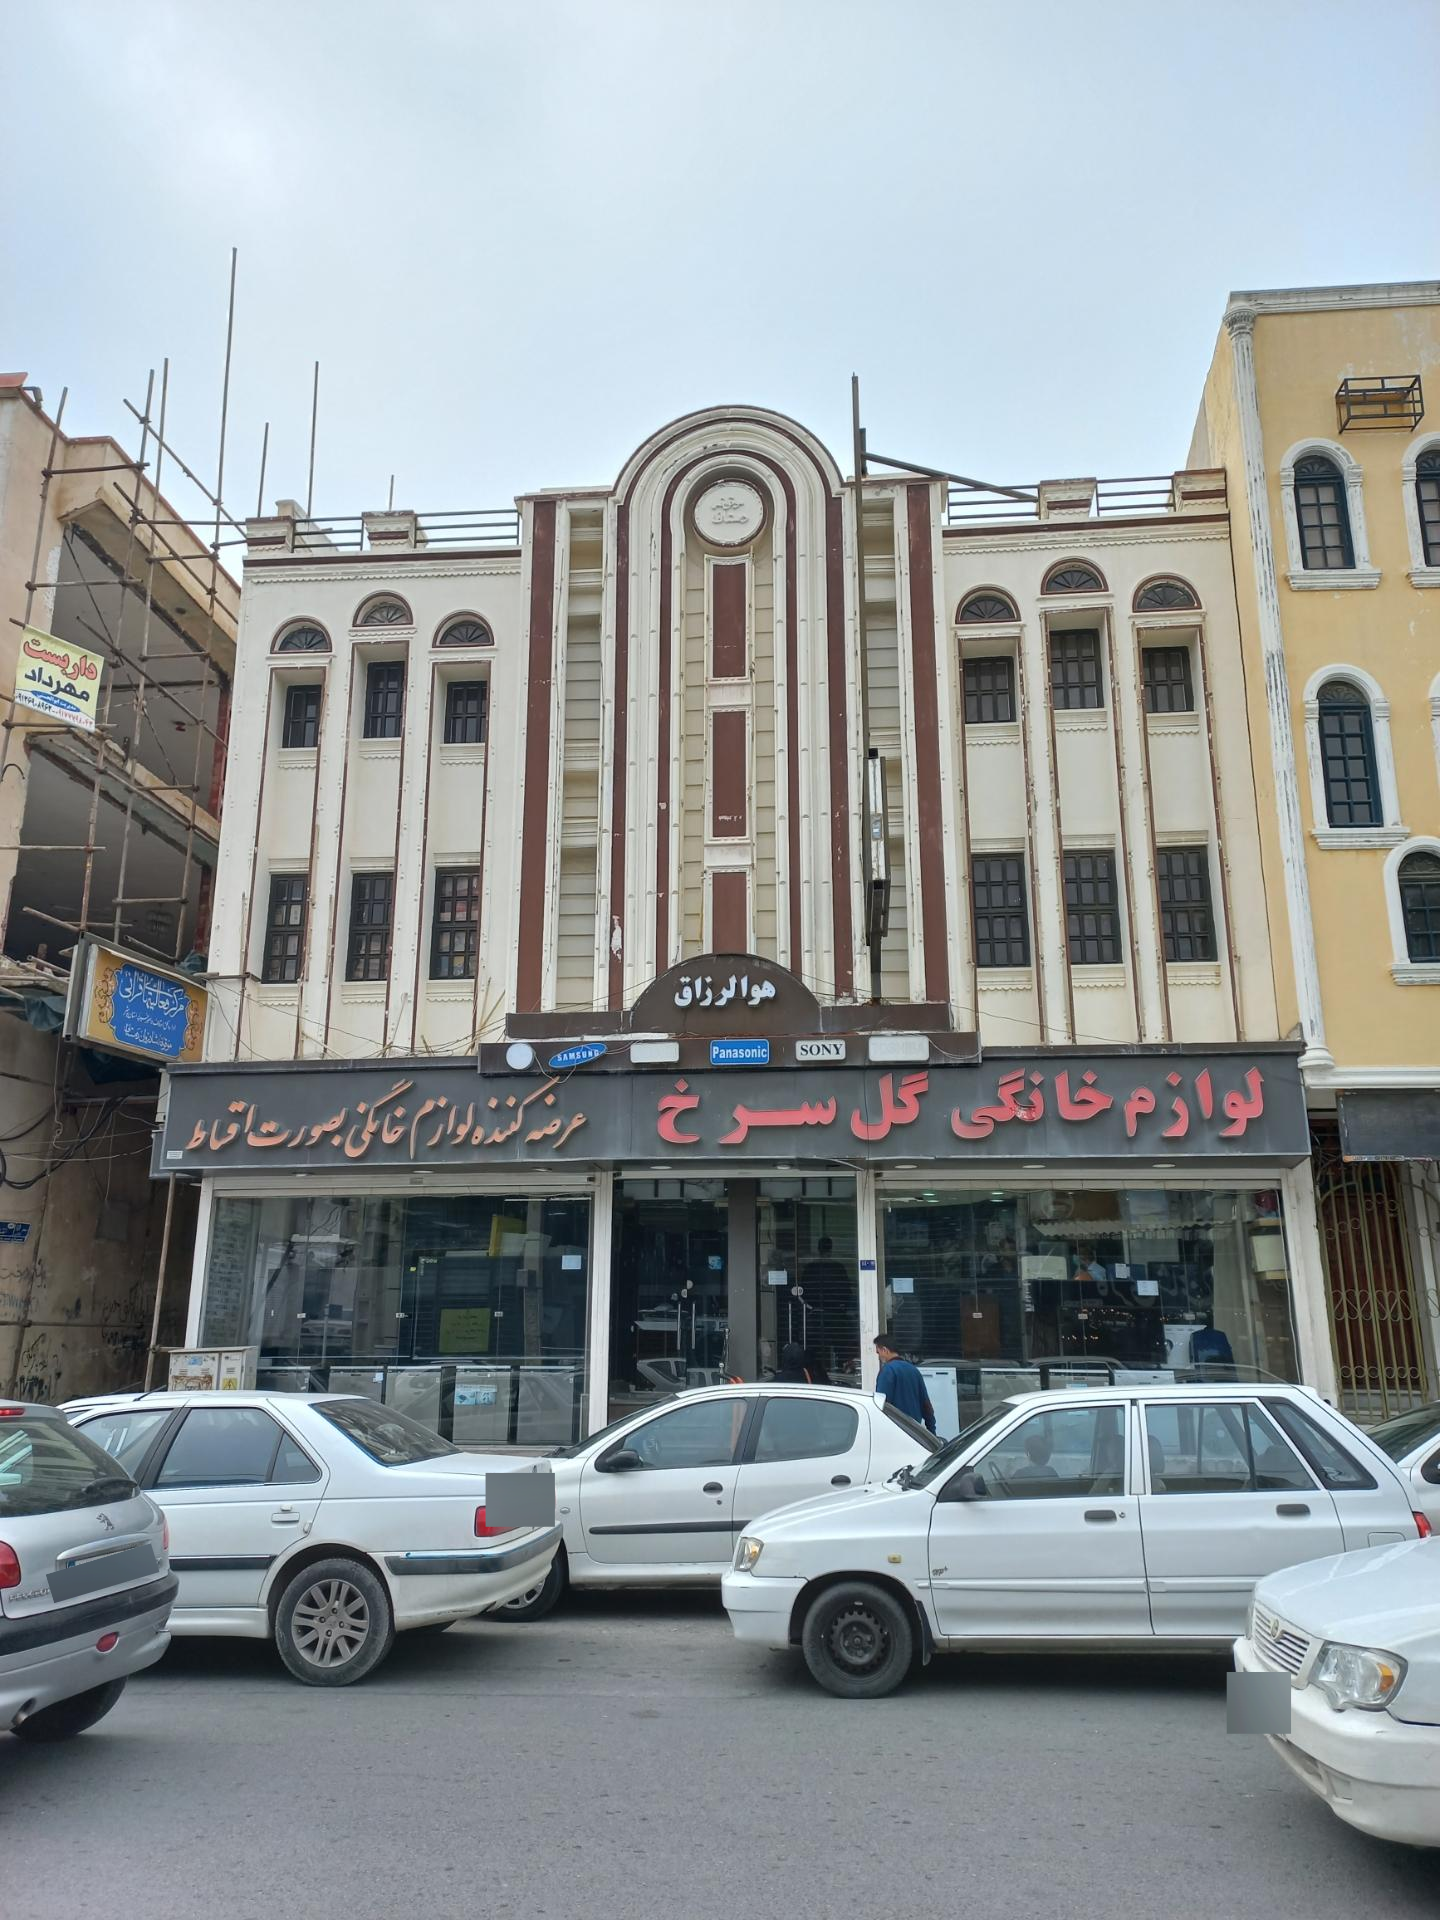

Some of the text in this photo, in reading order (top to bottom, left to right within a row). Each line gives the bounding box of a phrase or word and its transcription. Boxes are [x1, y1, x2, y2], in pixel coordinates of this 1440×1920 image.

[24, 667, 90, 702] مهرداد
[163, 986, 184, 1018] مرکز
[556, 1049, 600, 1062] SAMSUNG
[712, 1046, 768, 1059] Panasonic
[800, 1043, 843, 1056] SONY
[185, 1075, 587, 1160] عرضه کننده لوازم خانگی بصورت اقساط
[850, 1071, 929, 1141] گل
[951, 1067, 1114, 1139] خانگی
[1123, 1066, 1265, 1137] لوازم
